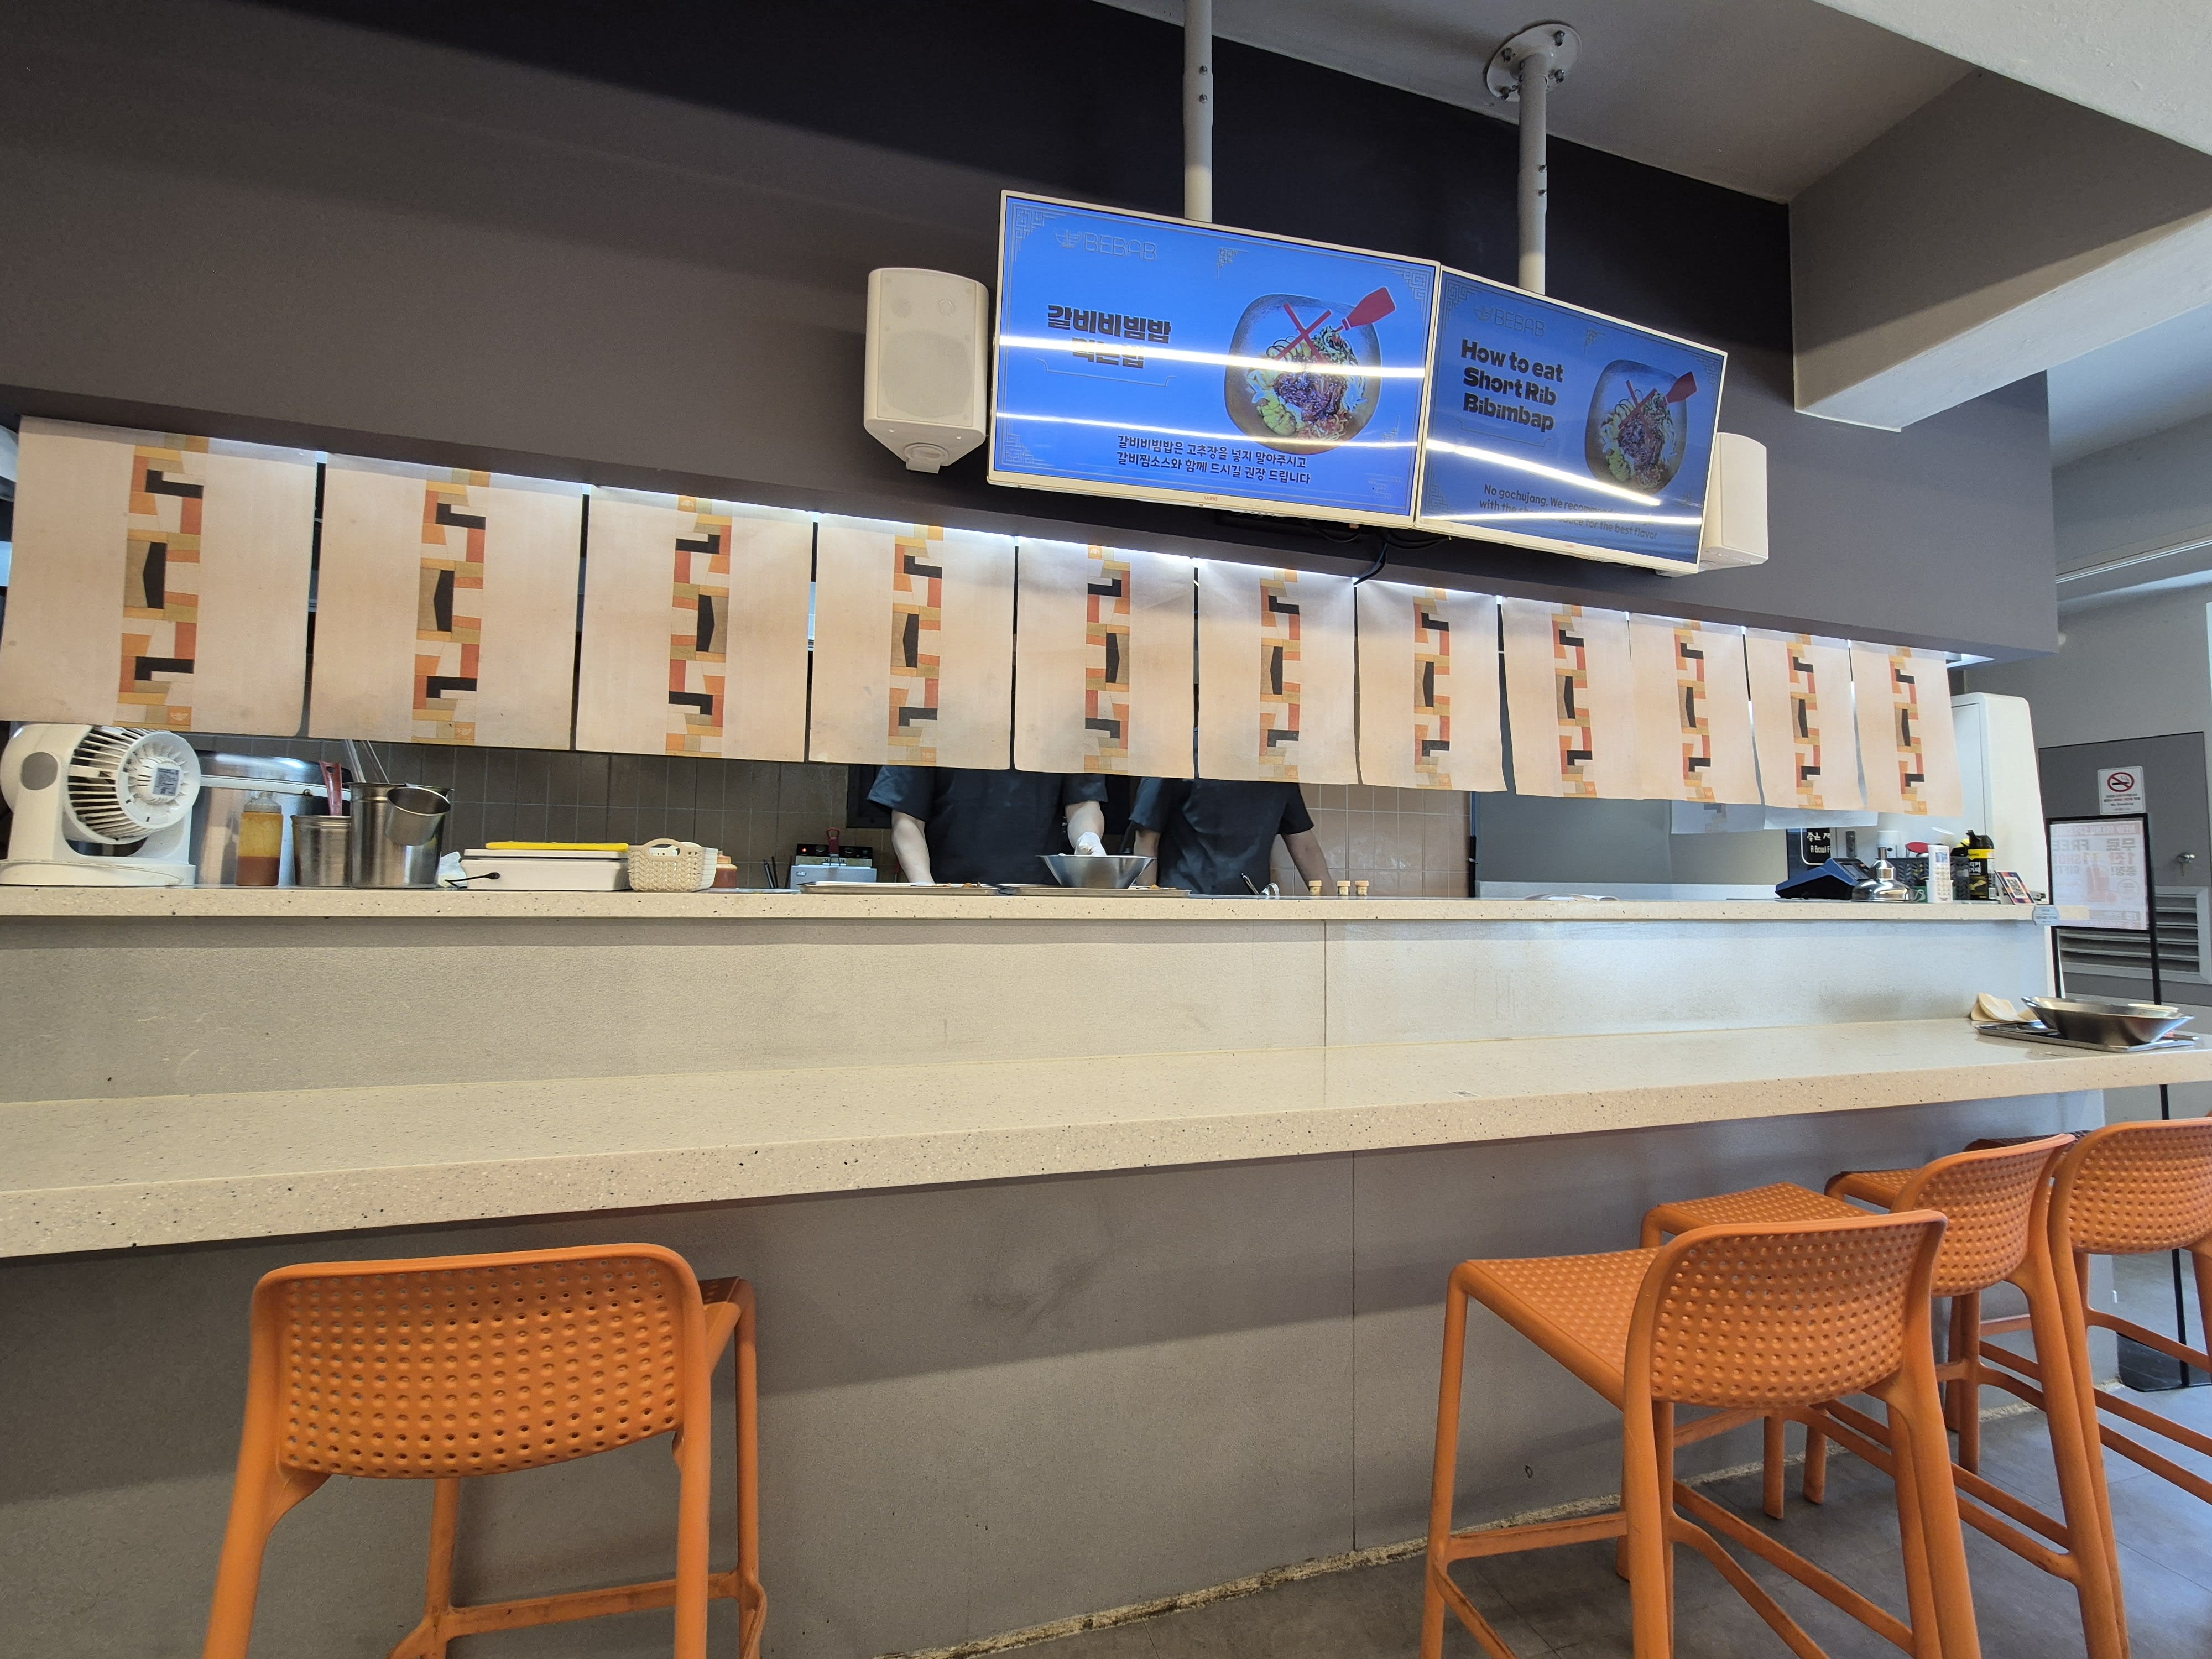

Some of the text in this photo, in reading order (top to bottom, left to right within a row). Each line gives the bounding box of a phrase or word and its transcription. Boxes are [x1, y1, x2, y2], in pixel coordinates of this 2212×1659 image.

[1084, 232, 1157, 261] BEBAB
[1048, 305, 1171, 344] 갈비비빔밥
[1494, 309, 1545, 337] BEBAB
[1460, 338, 1564, 383] How to eat
[1463, 366, 1557, 406] Short Rib
[1463, 392, 1554, 432] Bibimbap
[1118, 435, 1306, 468] 갈비비빔밥은 고추장을 넣지 말아주시고
[1117, 451, 1310, 484] 갈비찜소스와 함께 드시길 권장 드립니다
[1480, 499, 1500, 510] with
[1502, 503, 1517, 513] the
[1484, 484, 1496, 495] No
[1499, 489, 1548, 507] gochujang.
[1551, 497, 1562, 508] We
[1585, 519, 1599, 529] for
[1600, 521, 1613, 531] the
[1615, 524, 1633, 535] best
[1634, 527, 1658, 539] flavor
[1807, 832, 1822, 842] 좋은
